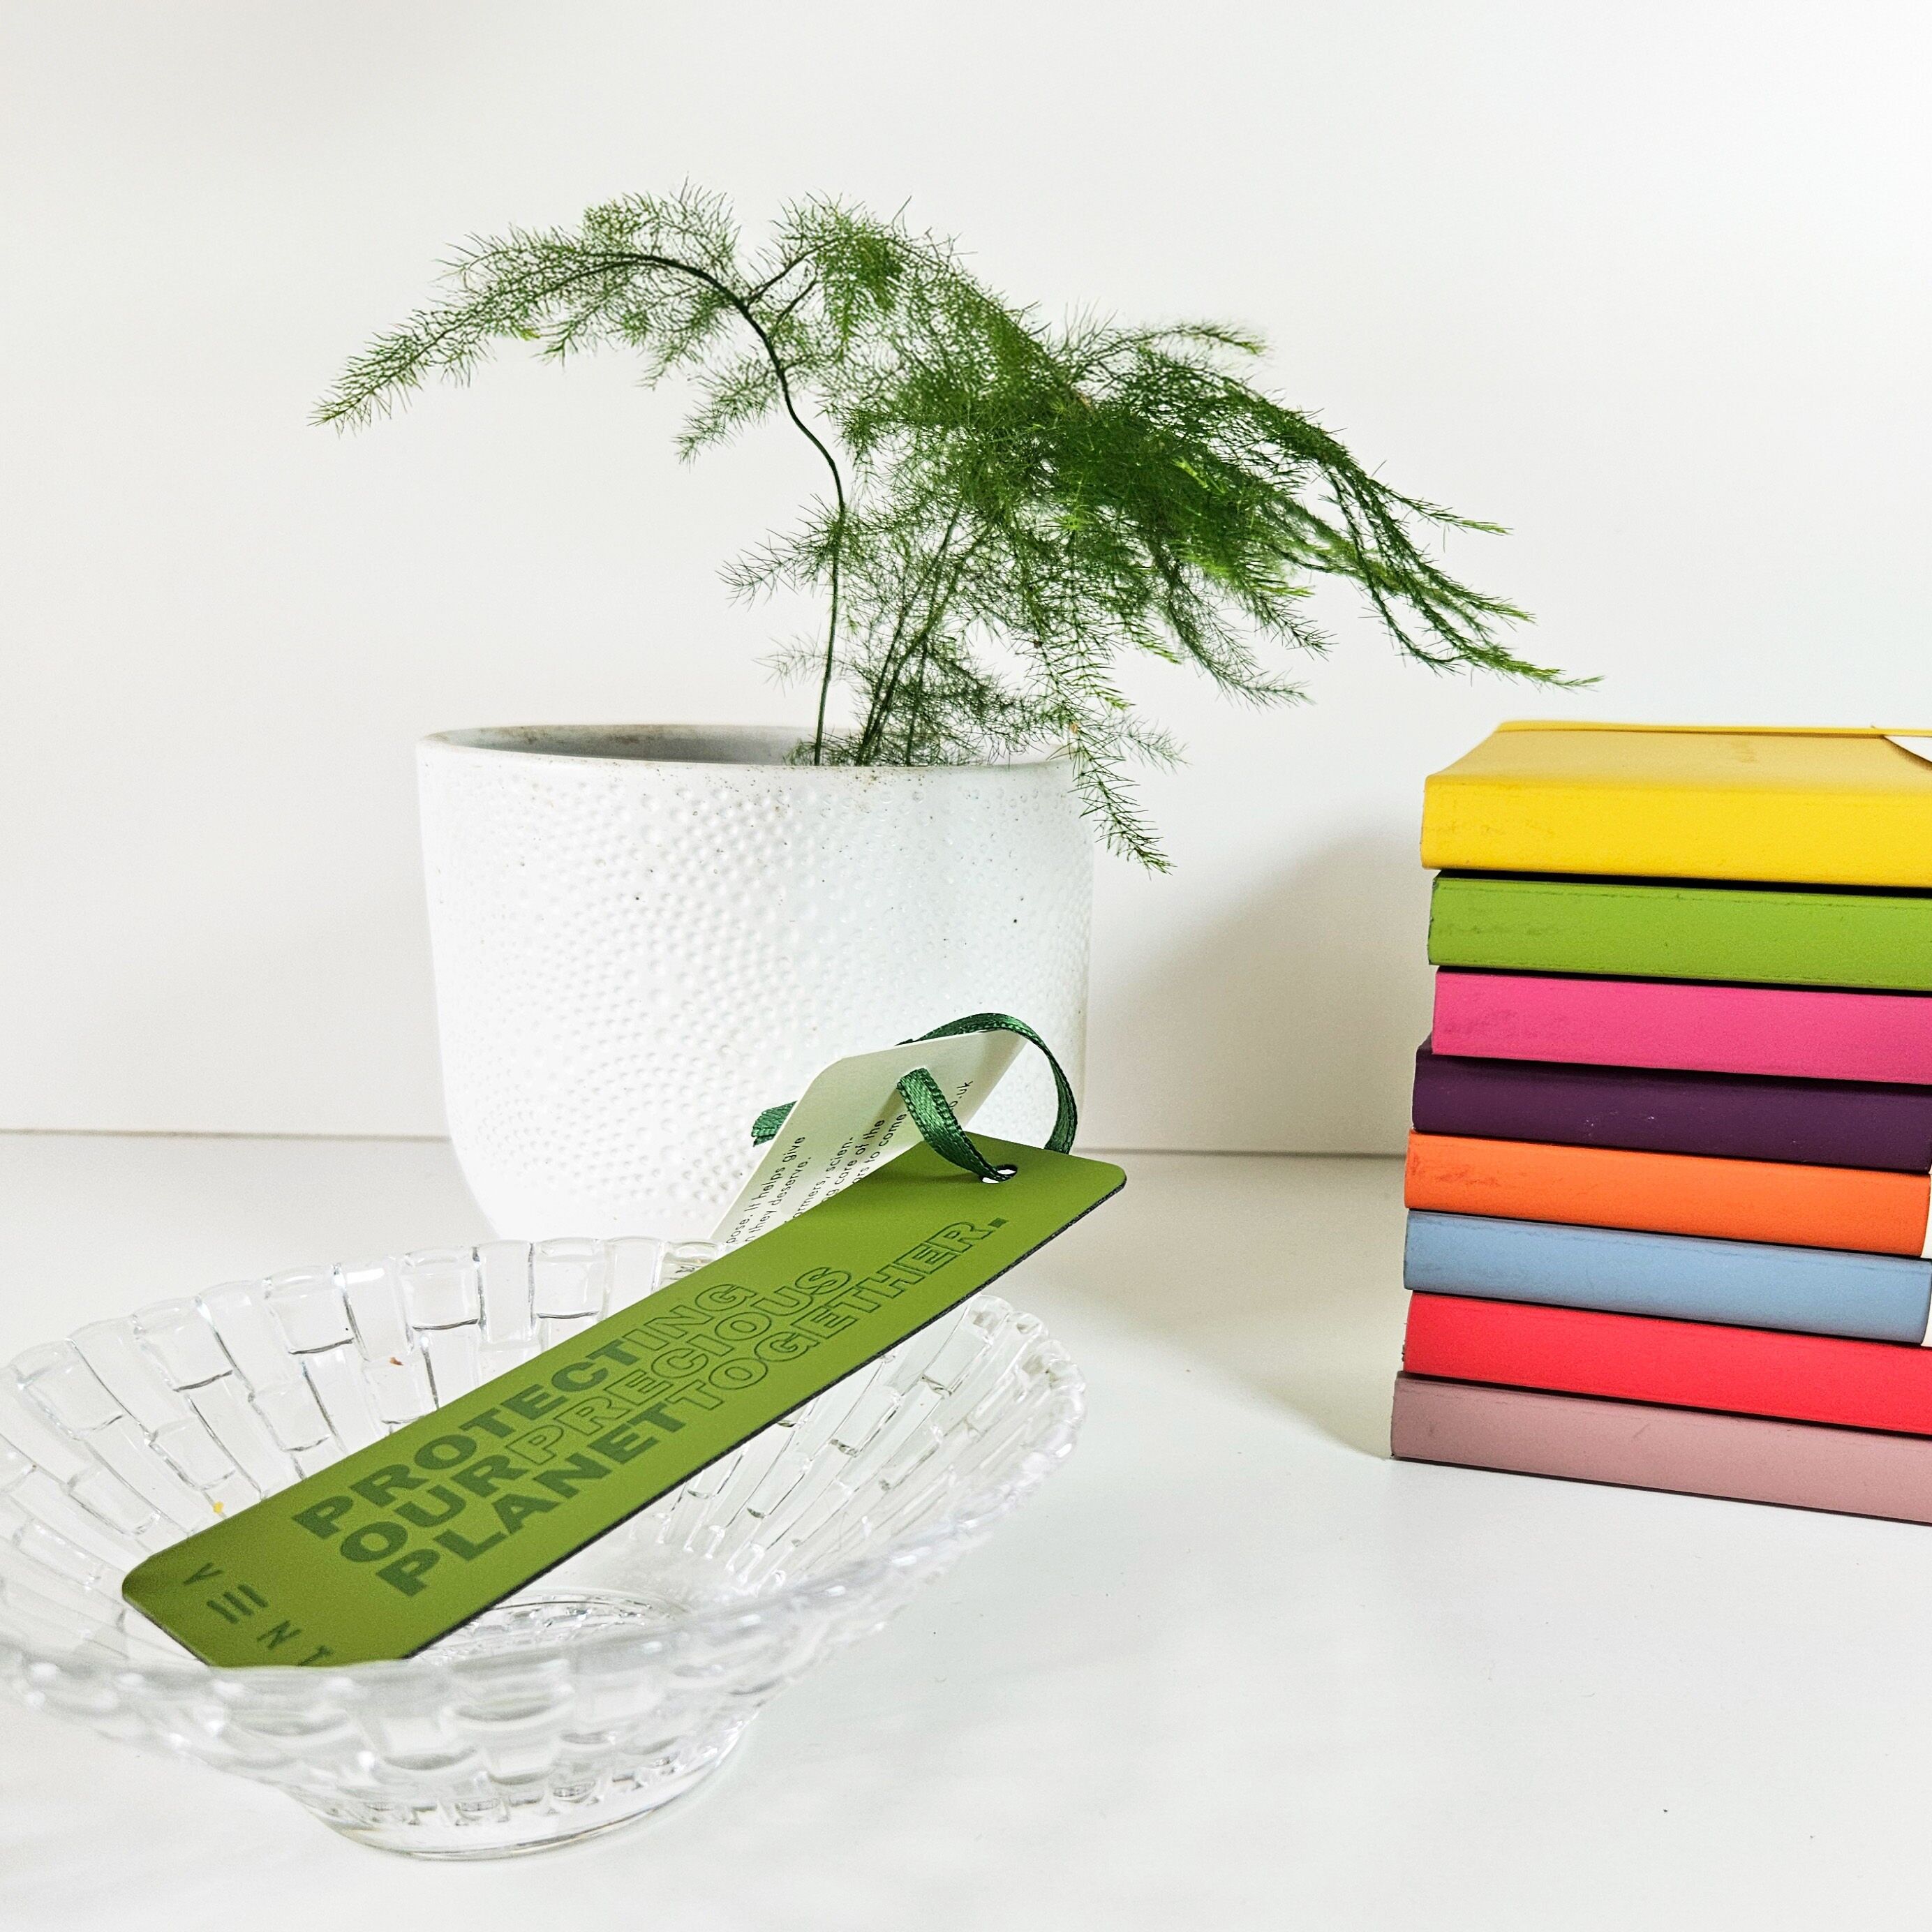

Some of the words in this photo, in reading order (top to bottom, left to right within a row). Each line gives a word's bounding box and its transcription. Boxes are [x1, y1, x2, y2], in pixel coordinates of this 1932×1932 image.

[949, 1081, 973, 1108] o.uk
[782, 1136, 805, 1163] give
[834, 1160, 858, 1185] care
[855, 1143, 870, 1155] of
[863, 1120, 885, 1140] the
[852, 1166, 870, 1184] ars
[864, 1151, 880, 1164] to
[749, 1210, 777, 1233] they
[768, 1157, 811, 1205] deserve.
[751, 1167, 785, 1201] helps
[785, 1176, 831, 1222] armers,
[826, 1137, 854, 1172] scien-
[726, 1214, 753, 1244] pose.
[744, 1203, 761, 1212] It
[292, 1284, 756, 1538] PROTECTING
[339, 1453, 528, 1563] OUR
[506, 1266, 852, 1464] PRECIOUS
[375, 1402, 686, 1598] PLANET
